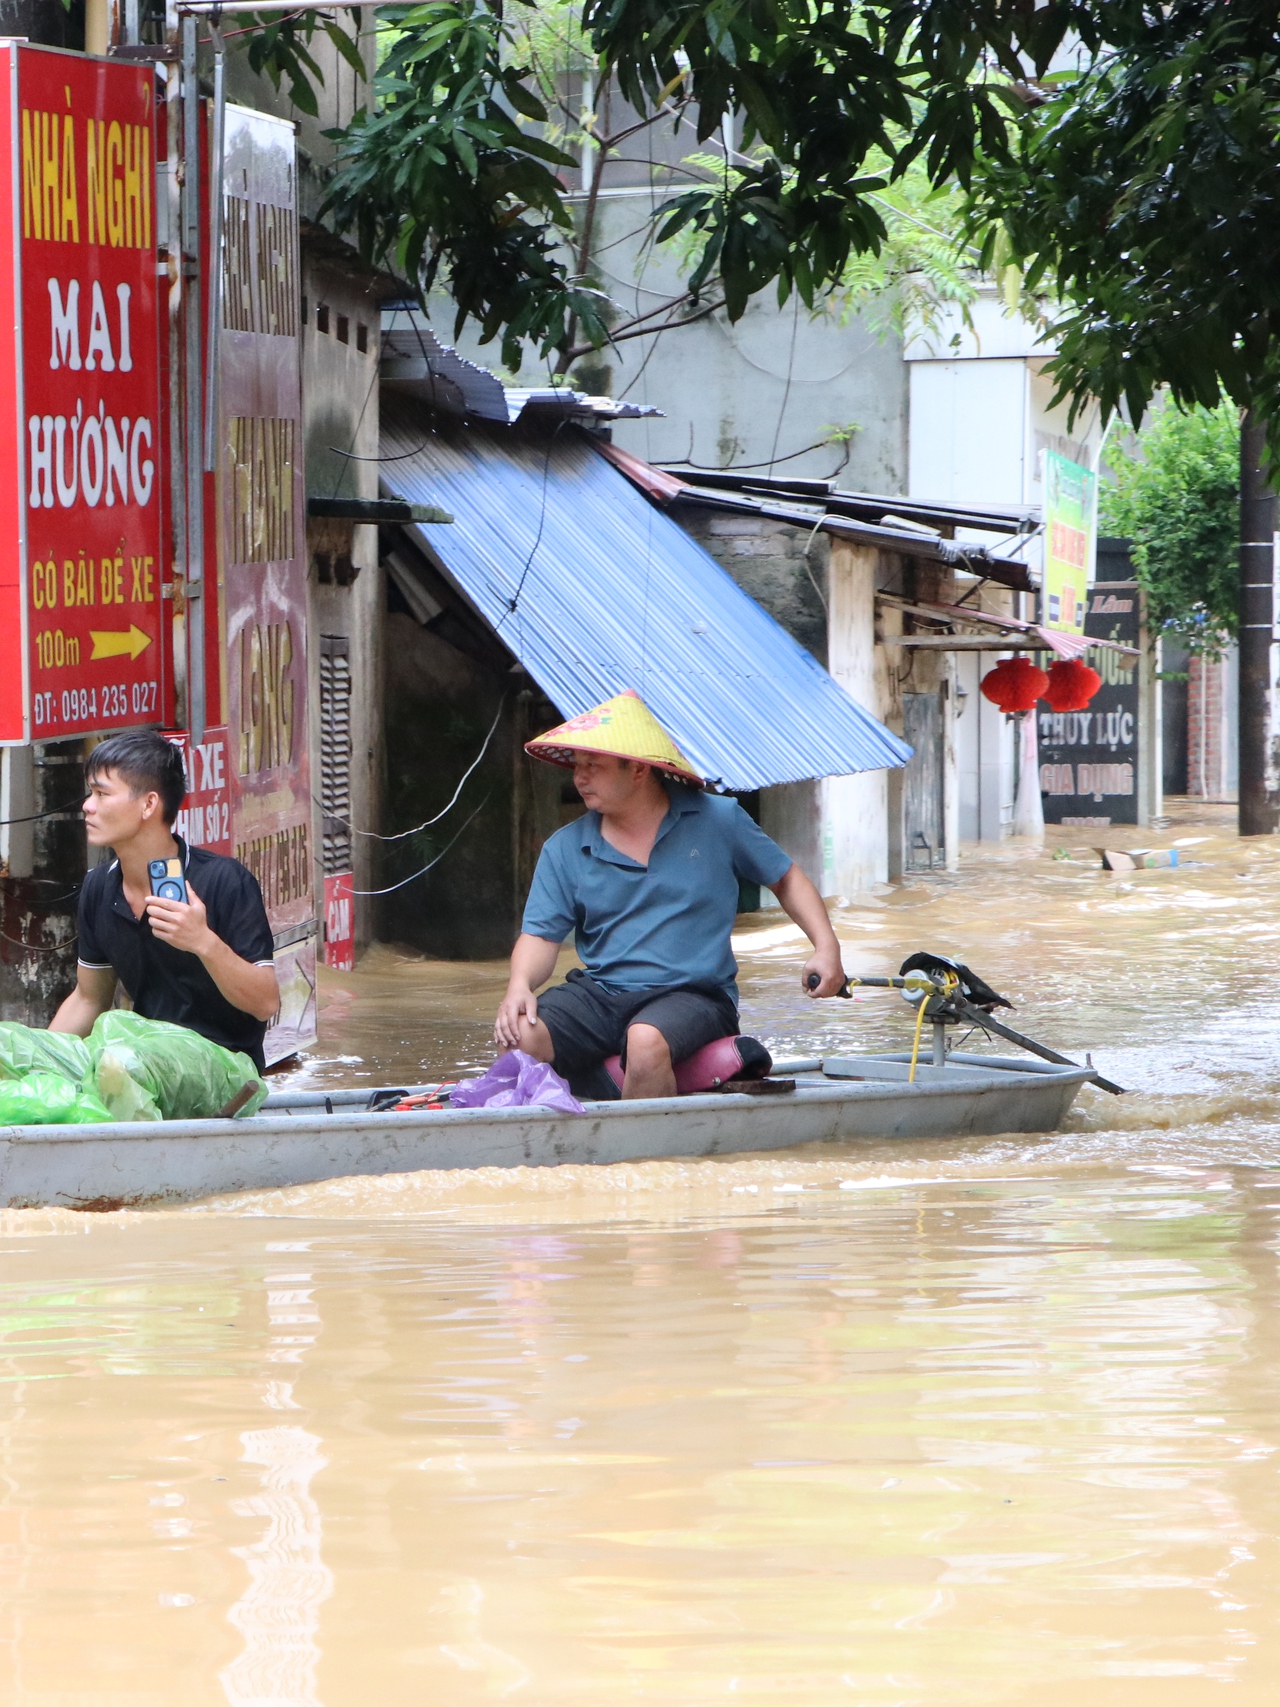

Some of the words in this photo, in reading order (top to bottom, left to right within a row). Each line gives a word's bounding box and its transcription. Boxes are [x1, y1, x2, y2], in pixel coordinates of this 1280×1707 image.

[22, 85, 79, 243] NHÀ
[87, 81, 151, 249] NGHỈ
[47, 277, 133, 373] MAI
[28, 397, 155, 509] HƯƠNG
[32, 550, 57, 610] CÓ
[63, 549, 95, 609] BÃI
[100, 537, 126, 606] ĐỂ
[131, 556, 155, 603] XE
[1089, 594, 1134, 614] Lâm
[35, 628, 80, 670] 100m
[34, 691, 58, 726] ĐT:
[62, 687, 97, 722] 0984
[102, 684, 127, 717] 235
[132, 681, 158, 714] 027
[238, 619, 294, 778] LONG
[1095, 703, 1134, 752] LỰC
[195, 741, 226, 792] XE
[1040, 762, 1075, 796] GIA
[1077, 762, 1134, 803] DỤNG
[206, 790, 221, 844] SỐ
[222, 802, 230, 840] 2
